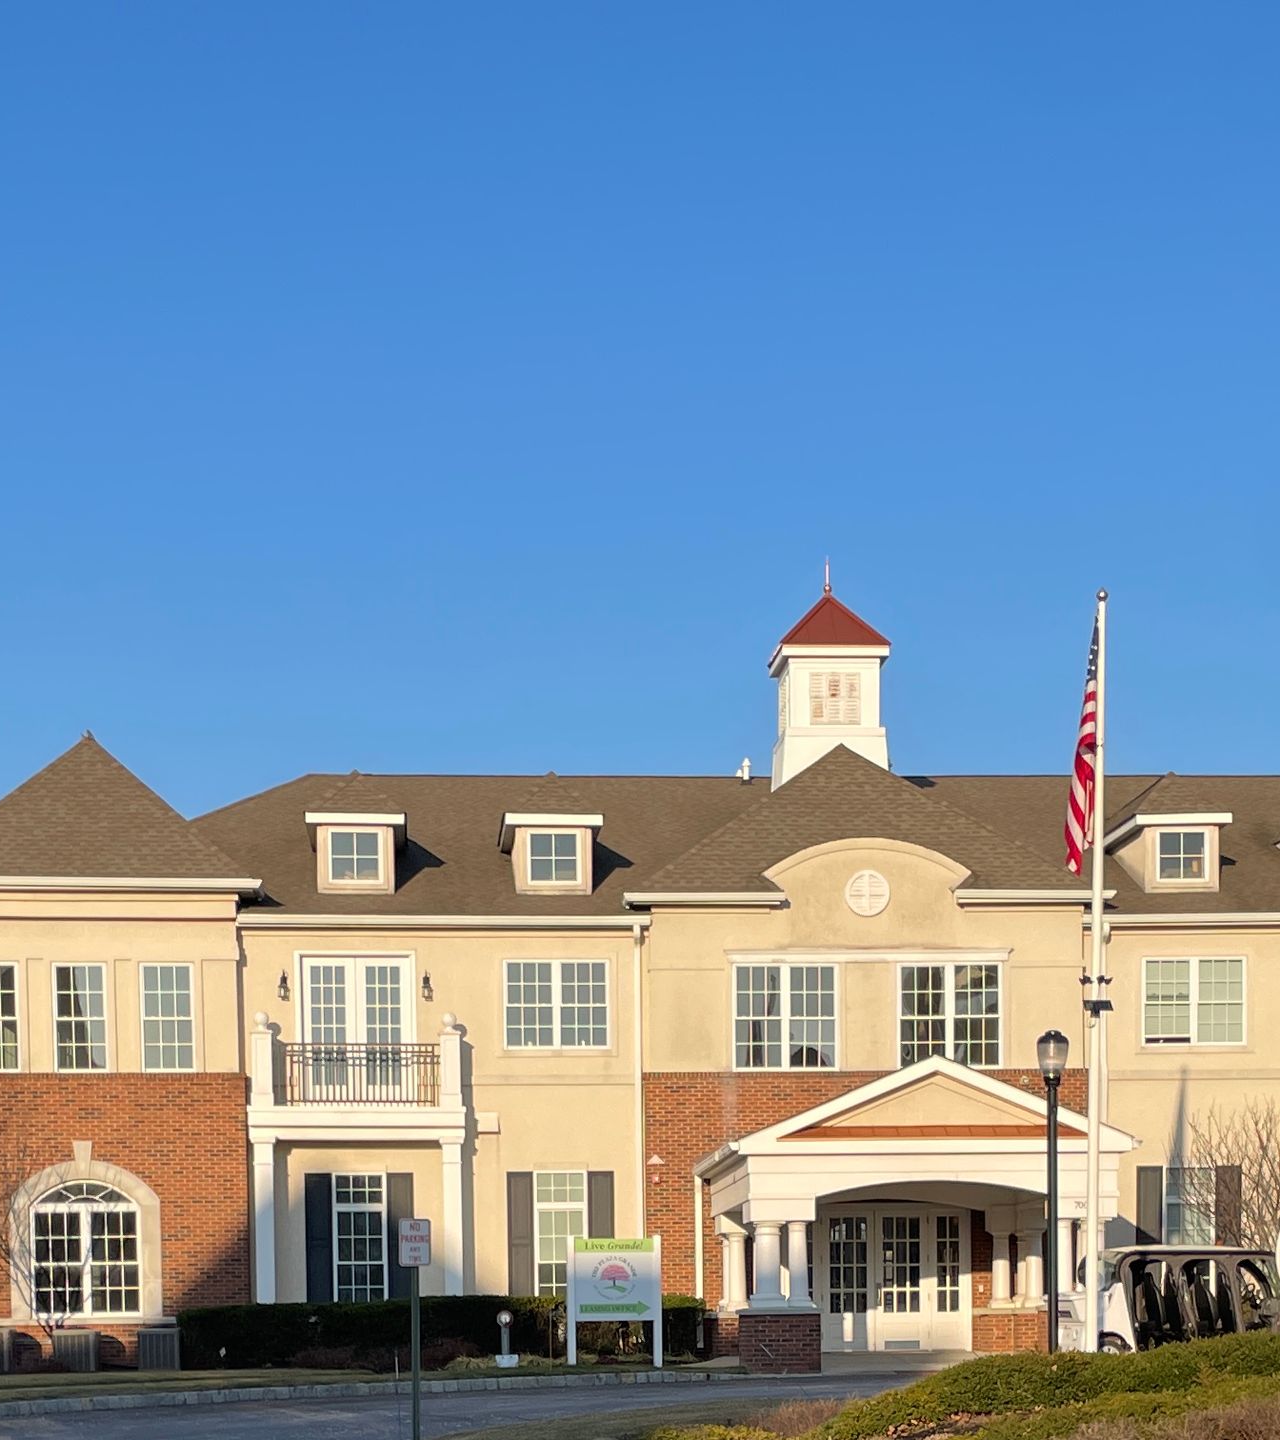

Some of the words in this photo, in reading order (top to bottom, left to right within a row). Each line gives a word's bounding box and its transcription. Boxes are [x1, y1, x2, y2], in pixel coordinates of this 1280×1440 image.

[410, 1222, 420, 1232] NO
[585, 1242, 605, 1250] Live
[607, 1241, 643, 1250] Grande!
